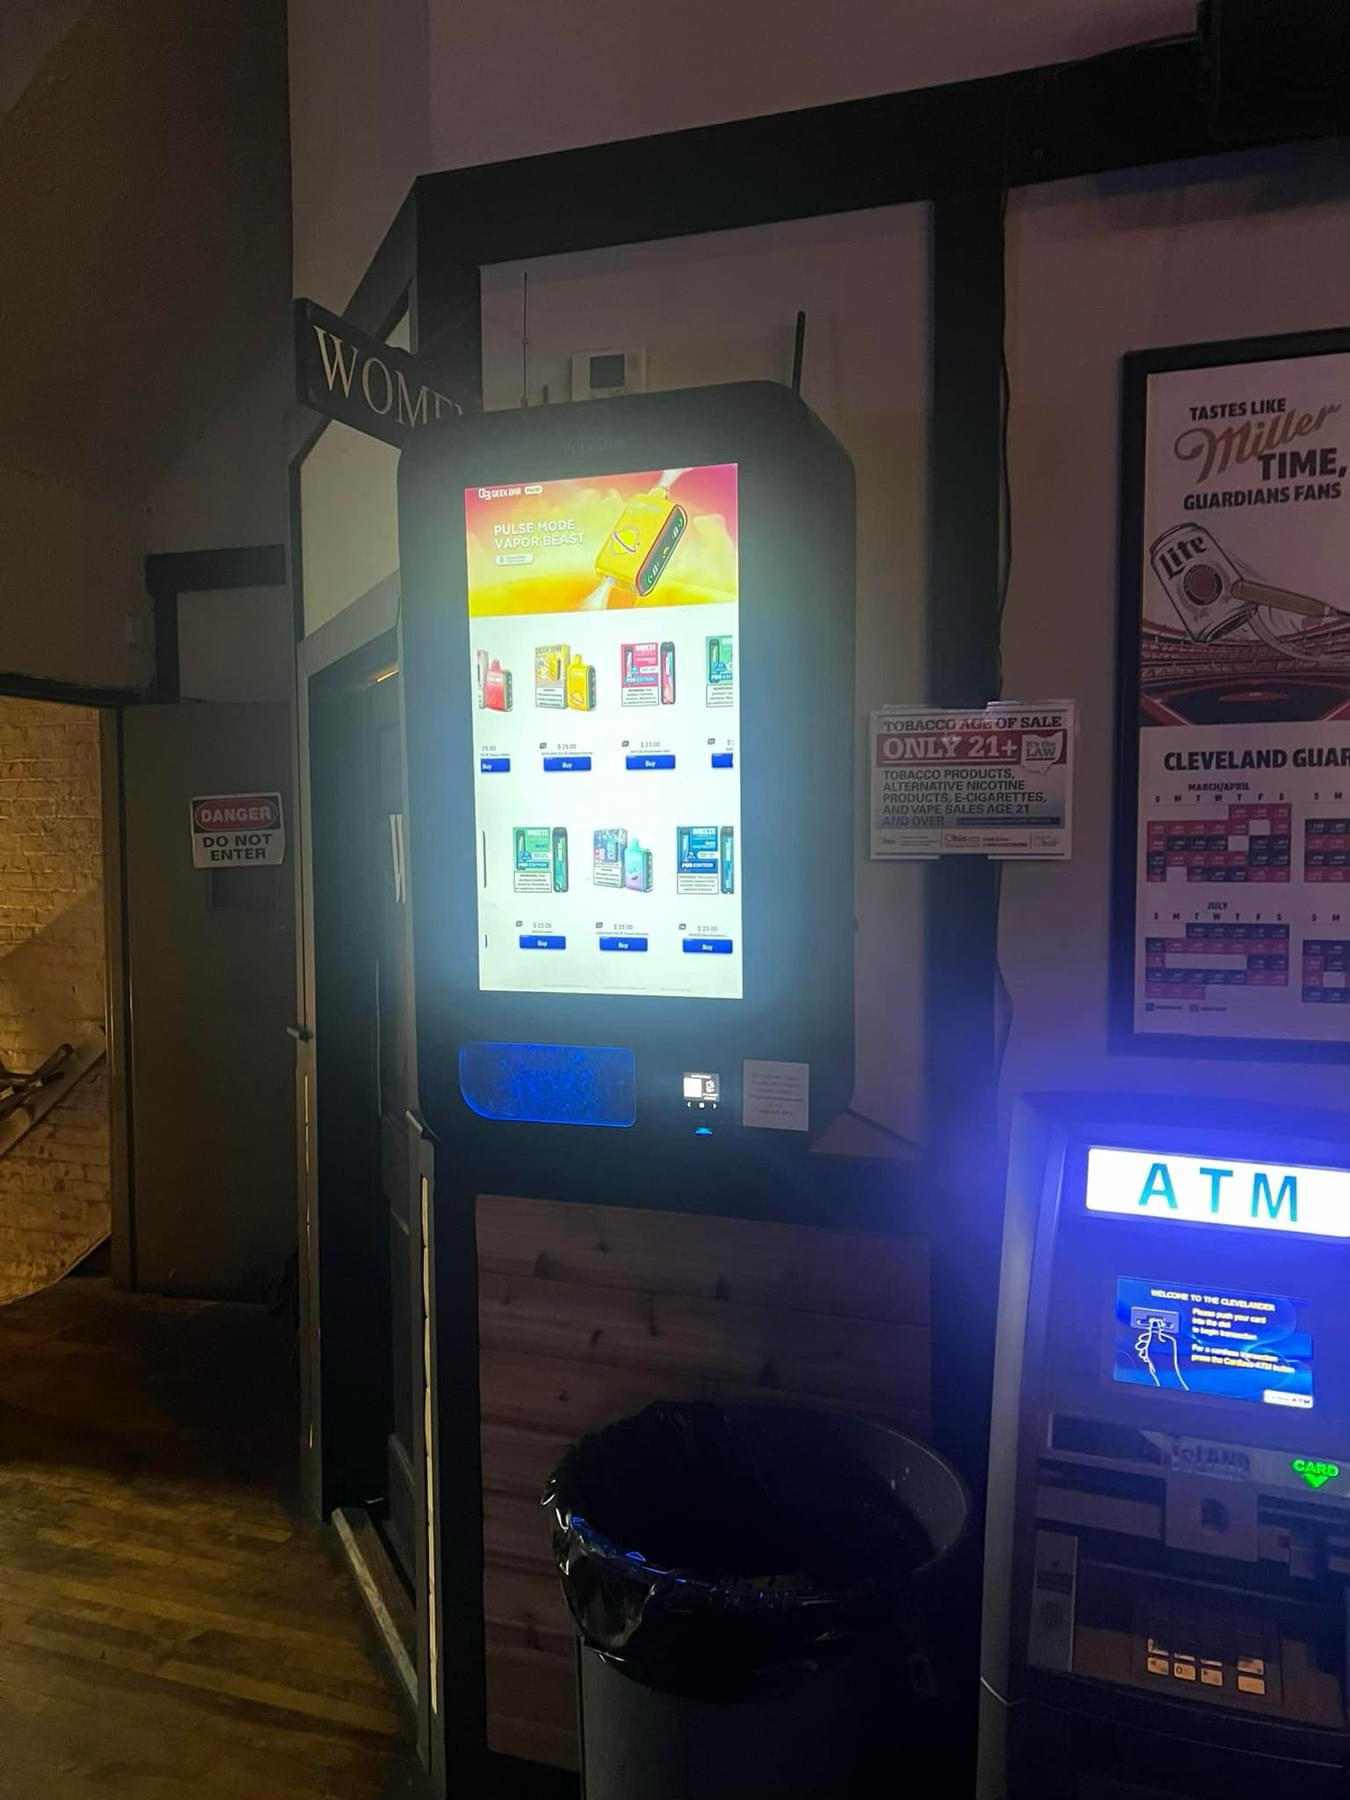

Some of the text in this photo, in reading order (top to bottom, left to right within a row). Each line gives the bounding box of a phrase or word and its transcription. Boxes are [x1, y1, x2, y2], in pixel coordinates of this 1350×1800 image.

[1189, 398, 1287, 421] TASTES LIKE
[1174, 404, 1342, 484] Miller
[1257, 448, 1347, 481] TIME,
[1183, 482, 1342, 511] GUARDIANS FANS
[494, 519, 575, 537] PULSE MODE
[494, 532, 584, 549] VAPOR BEAST
[1158, 536, 1207, 581] Lite
[884, 716, 1062, 732] TOBACCO AGE OF SALE
[883, 735, 1017, 759] ONLY 21+
[1026, 747, 1056, 757] LAW
[482, 763, 492, 771] Buy
[562, 761, 573, 769] Buy
[645, 760, 656, 768] Buy
[1164, 751, 1288, 771] CLEVELAND
[884, 768, 1016, 781] TOBACCO PRODUCTS,
[883, 780, 1025, 792] ALTERNATIVE NICOTINE
[1188, 782, 1250, 792] MARCH/APRIL
[955, 791, 1047, 804] E-CIGARETTES,
[1334, 792, 1342, 800] M
[201, 806, 271, 823] DANGER
[883, 804, 1029, 815] AND VAPE SALES AGE 21
[883, 816, 909, 827] AND
[912, 816, 944, 827] OVER
[203, 833, 272, 848] DO NOT
[210, 848, 266, 861] ENTER
[1207, 902, 1228, 910] JULY
[537, 940, 548, 948] Buy
[618, 942, 629, 950] Buy
[702, 943, 713, 951] Buy
[1138, 1163, 1298, 1222] ATM
[1151, 1289, 1189, 1301] WELCOME
[1190, 1294, 1203, 1303] TO
[1203, 1295, 1220, 1305] THE
[1192, 1307, 1216, 1318] Please
[1233, 1314, 1250, 1322] your
[1291, 1459, 1340, 1478] CARD
